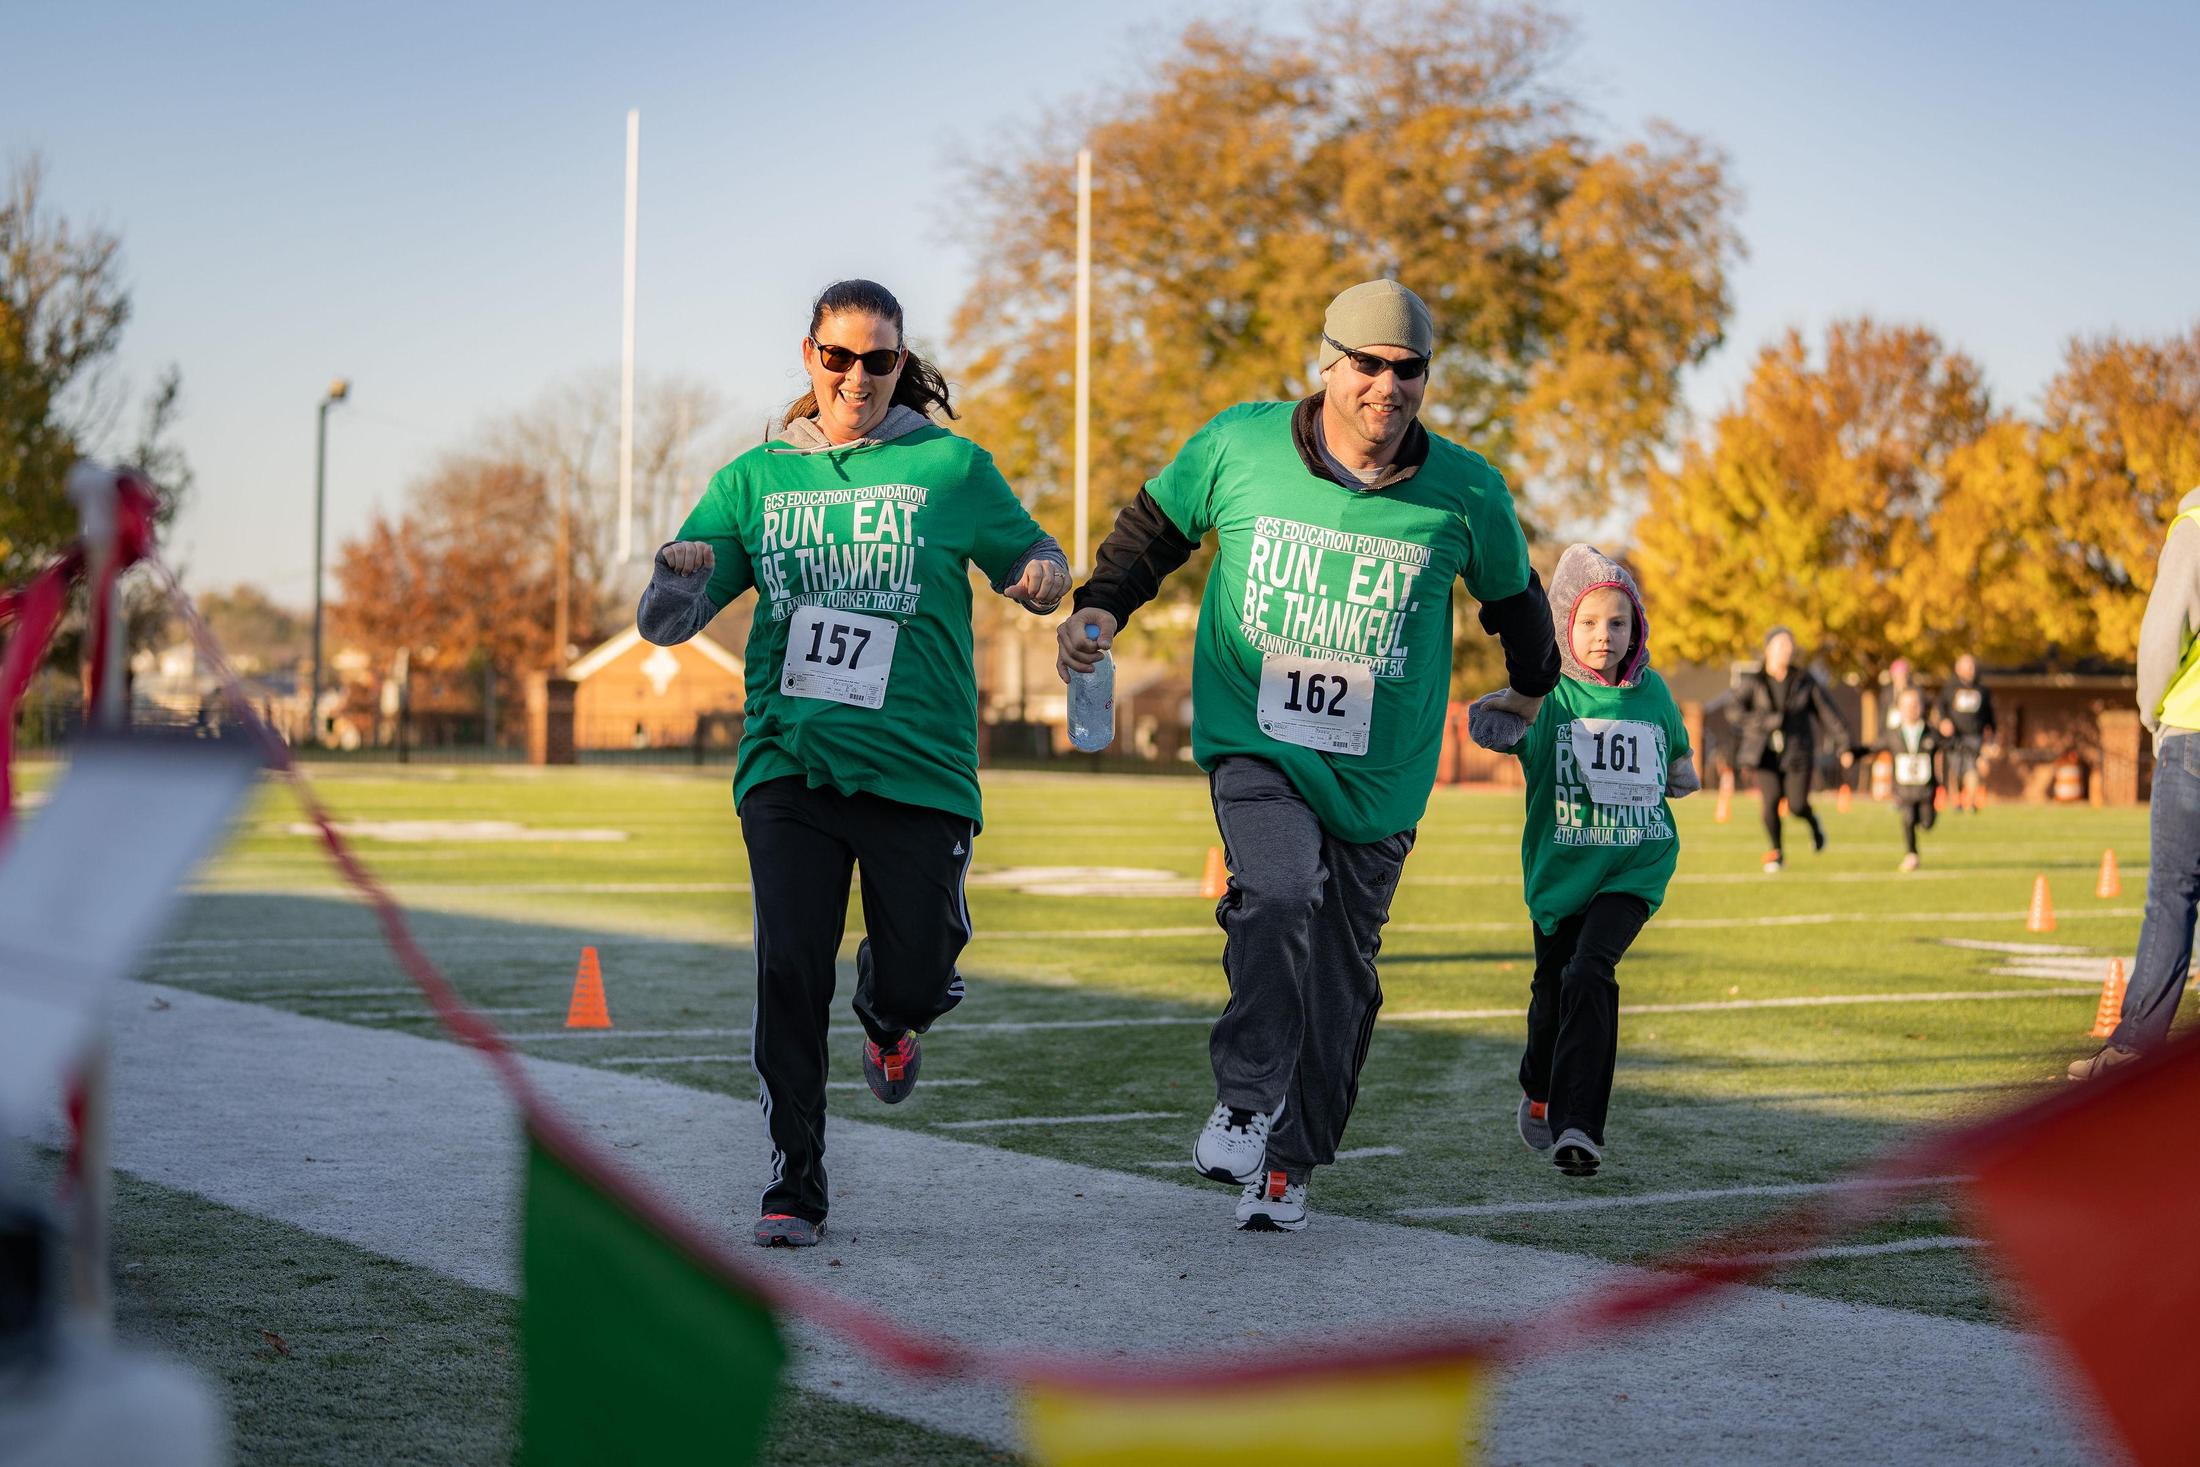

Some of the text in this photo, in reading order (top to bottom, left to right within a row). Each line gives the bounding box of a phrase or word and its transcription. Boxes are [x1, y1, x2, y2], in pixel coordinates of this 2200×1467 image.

[764, 485, 927, 512] GCS EDUCATION FOUNDATION
[762, 500, 925, 554] RUN. EAT.
[1254, 516, 1432, 566] GCS EDUCATION FOUNDATION
[762, 543, 922, 601] BE THANKFUL.
[1247, 534, 1422, 612] RUN. EAT.
[826, 592, 872, 608] TURKEY
[872, 592, 901, 611] TROT
[901, 596, 918, 614] 5K
[1242, 577, 1409, 657] BE THANKFUL.
[805, 621, 872, 670] 157
[1388, 660, 1405, 676] 5K
[1284, 670, 1349, 718] 162
[1591, 732, 1641, 774] 161
[1555, 785, 1583, 828] BE
[1554, 827, 1574, 844] 4TH
[1574, 829, 1617, 845] ANNUAL
